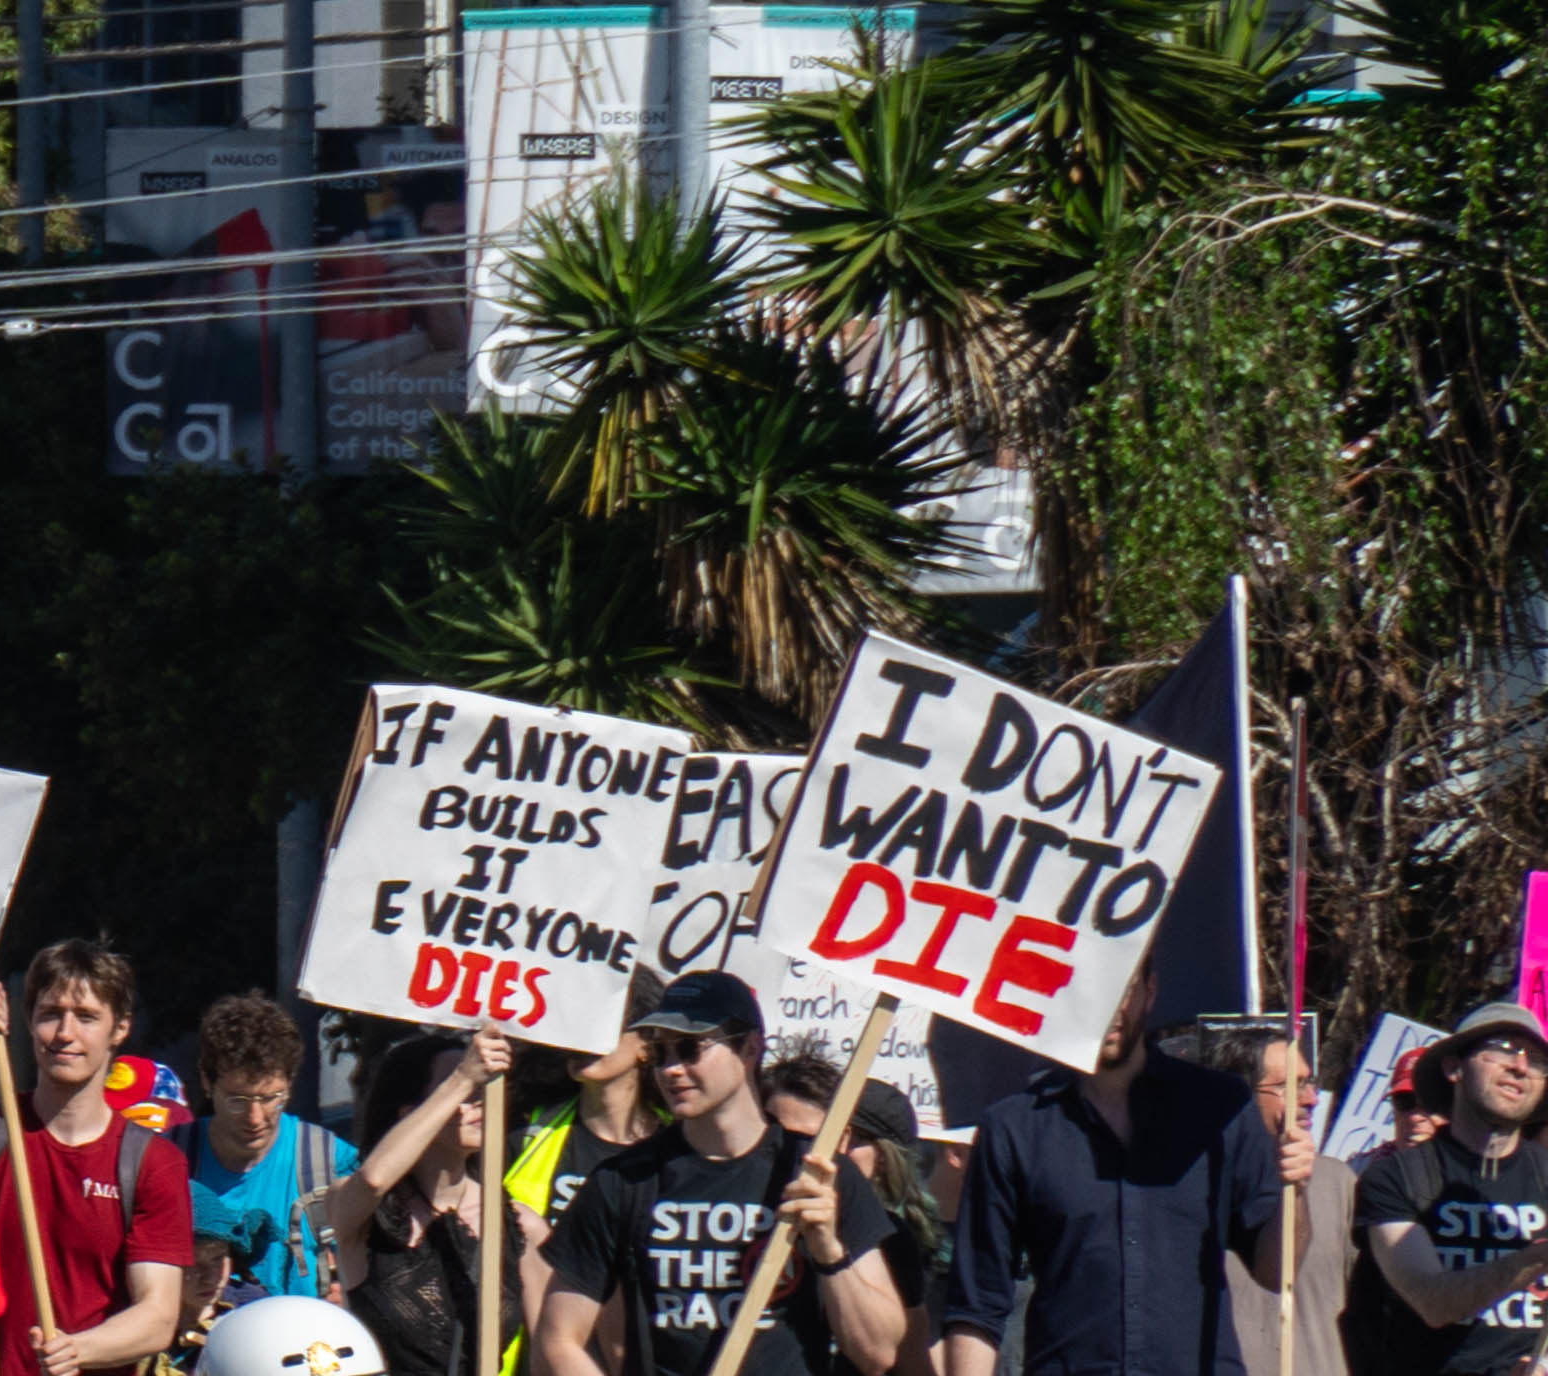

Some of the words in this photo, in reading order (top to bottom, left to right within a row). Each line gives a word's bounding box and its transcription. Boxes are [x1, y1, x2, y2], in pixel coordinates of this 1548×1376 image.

[600, 110, 667, 126] DESIGN
[211, 152, 278, 167] ANALOG
[372, 701, 455, 768] IF
[464, 714, 684, 803] ANYONE
[856, 658, 956, 768] I
[961, 692, 1201, 853] DON'T
[419, 784, 610, 850] BUILDS
[660, 755, 804, 870] EAS
[455, 845, 530, 894] IT
[819, 762, 1062, 902] WANT
[1058, 833, 1167, 939] TO
[369, 879, 641, 975] EVERYONE
[808, 861, 1079, 1037] DIE
[407, 941, 551, 1028] DIES
[778, 982, 849, 1021] anch
[650, 1200, 775, 1243] STOP
[1436, 1200, 1548, 1240] STOP
[647, 1248, 745, 1289] THE
